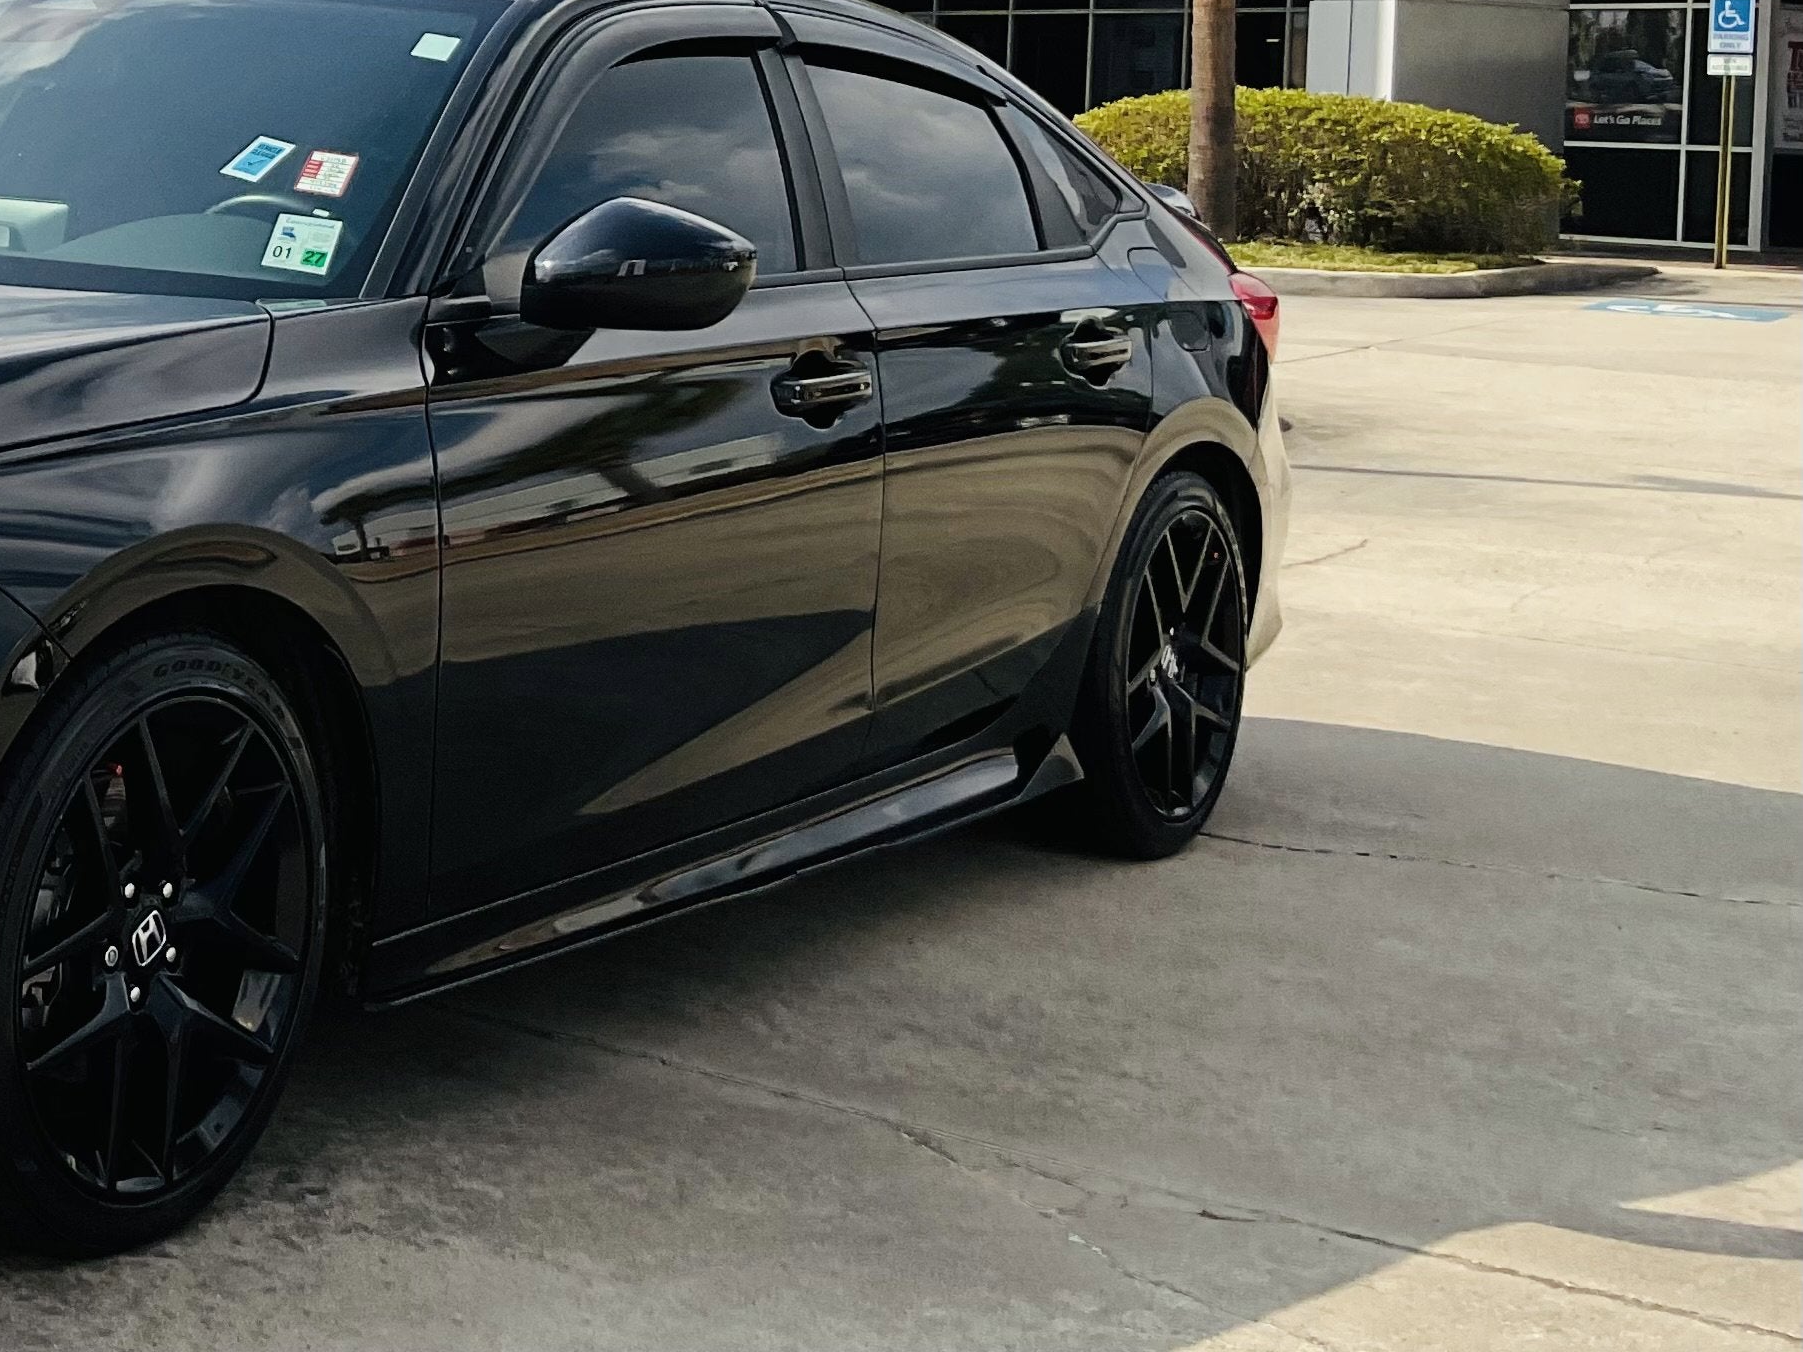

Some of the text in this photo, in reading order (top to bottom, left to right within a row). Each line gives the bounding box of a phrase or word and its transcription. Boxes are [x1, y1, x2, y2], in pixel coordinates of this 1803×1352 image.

[1594, 113, 1662, 126] Let's Go Places
[272, 245, 327, 264] 01 27
